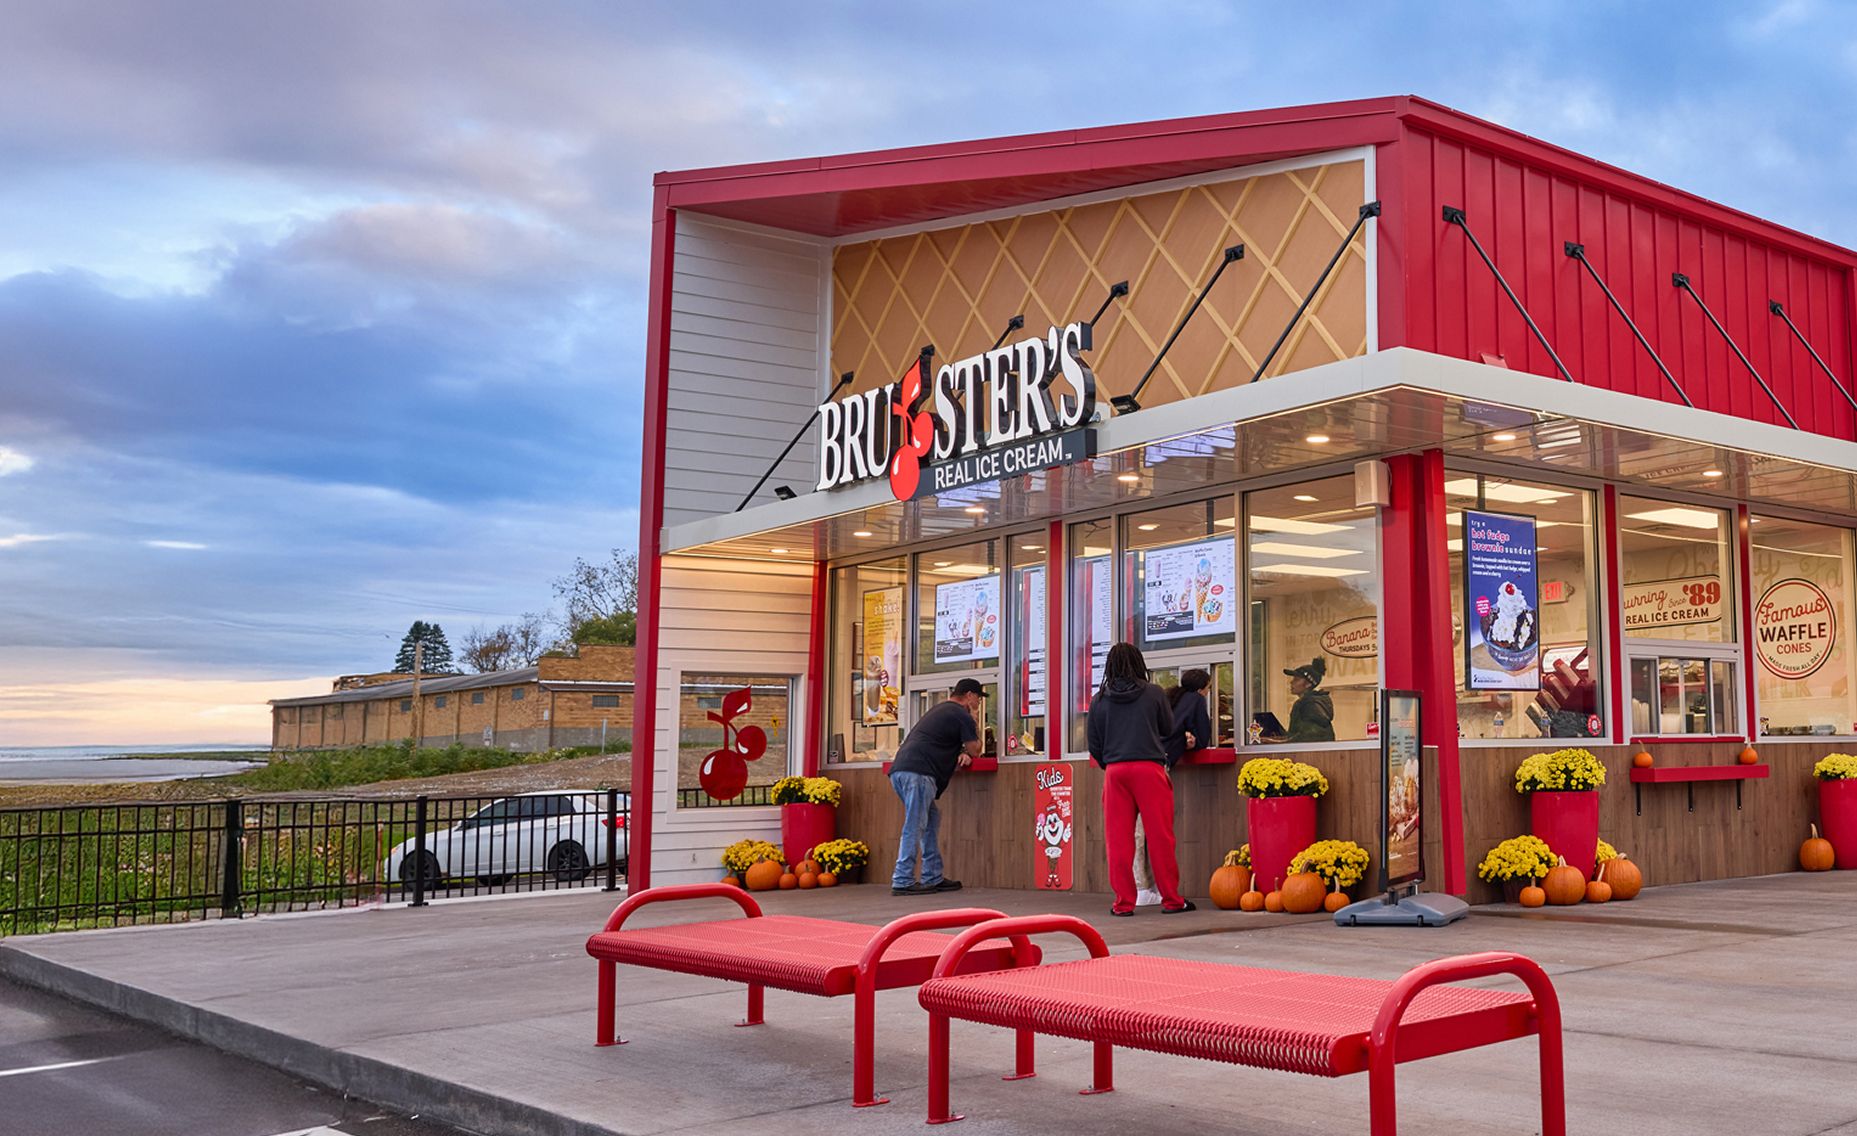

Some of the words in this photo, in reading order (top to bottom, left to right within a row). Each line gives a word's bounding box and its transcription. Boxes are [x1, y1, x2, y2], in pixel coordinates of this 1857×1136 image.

[935, 464, 974, 490] REAL
[976, 455, 1001, 479] ICE
[1003, 437, 1063, 474] CREAM
[1472, 528, 1485, 540] hot
[1487, 529, 1510, 544] fudge
[1472, 540, 1504, 553] brownie
[1505, 546, 1532, 555] sundae
[1544, 581, 1563, 601] EXIT
[1682, 582, 1721, 606] '89
[1626, 614, 1649, 625] REAL
[1651, 612, 1668, 623] ICE
[1671, 607, 1709, 620] CREAM
[1759, 597, 1828, 625] Famous
[1326, 628, 1370, 648] Banana
[1759, 622, 1827, 642] WAFFLE
[1338, 643, 1370, 652] THURSDAYS
[1776, 643, 1812, 655] CONES
[1768, 655, 1782, 670] MADE
[1800, 660, 1811, 670] ALL
[1810, 652, 1821, 666] DAY
[1036, 767, 1064, 790] Kids
